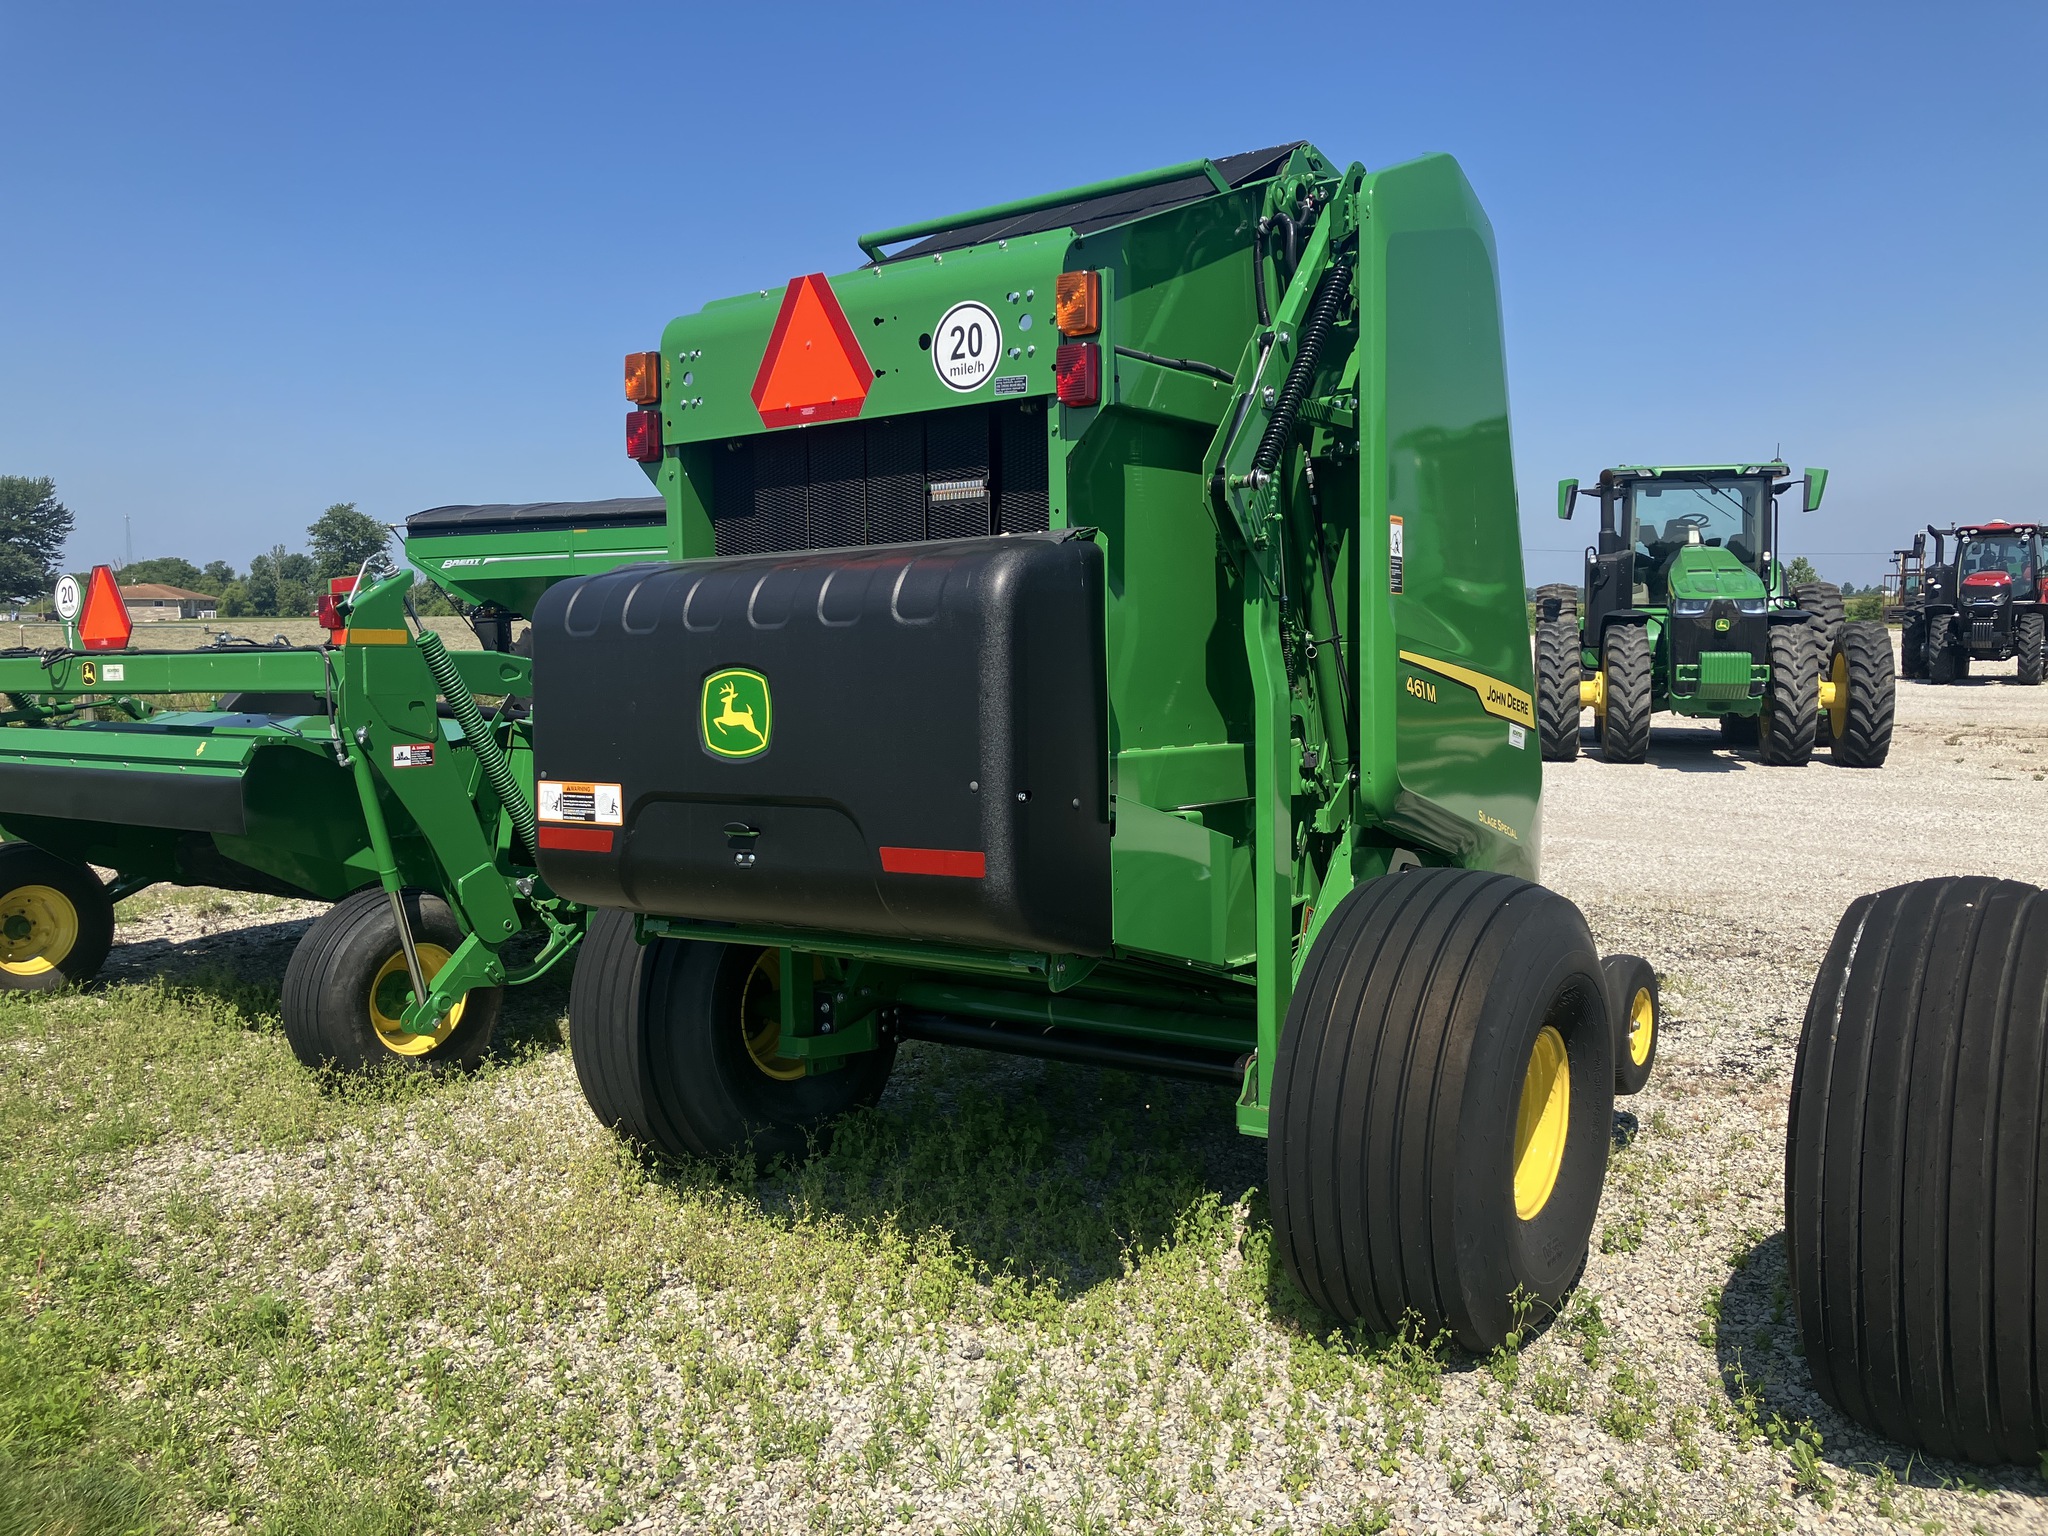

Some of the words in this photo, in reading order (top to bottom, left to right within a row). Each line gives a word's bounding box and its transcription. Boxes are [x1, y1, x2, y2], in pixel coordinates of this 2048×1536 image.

[950, 322, 983, 361] 20
[950, 361, 985, 377] mile/h
[441, 558, 481, 569] BRENT
[61, 585, 74, 604] 20
[1486, 685, 1507, 706] JOHN
[1507, 692, 1529, 715] DEERE
[1478, 809, 1498, 830] SILAGE
[1497, 819, 1518, 840] SPECIAL
